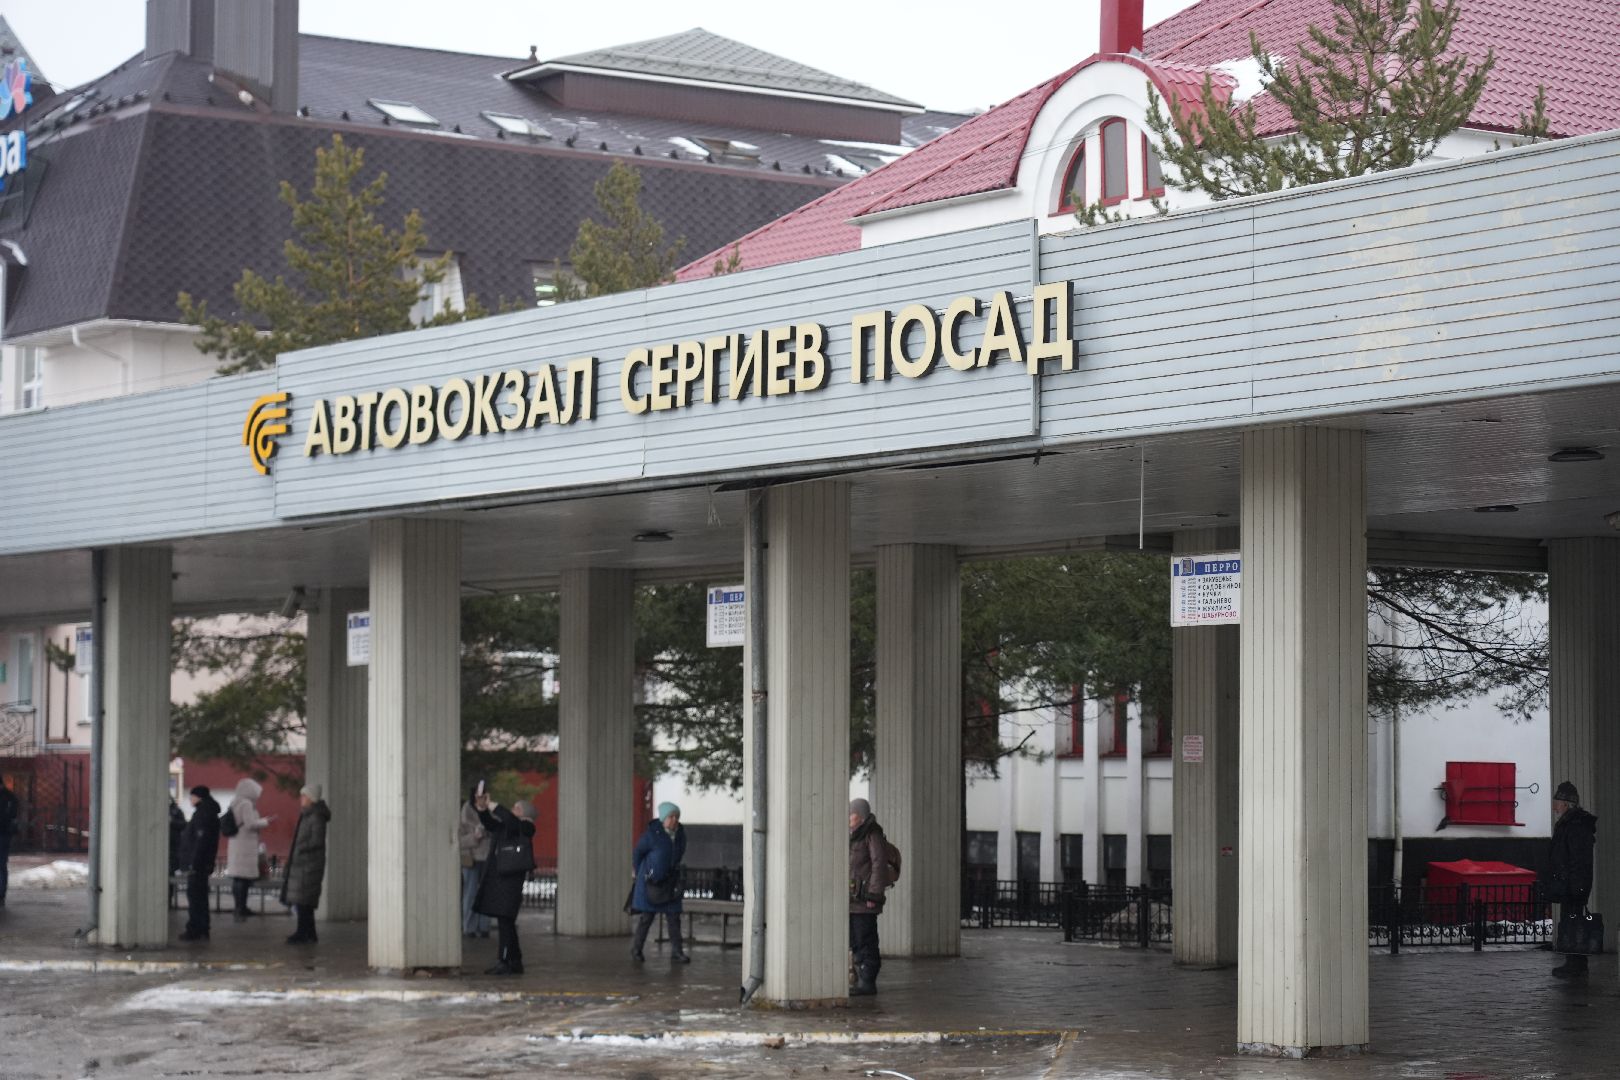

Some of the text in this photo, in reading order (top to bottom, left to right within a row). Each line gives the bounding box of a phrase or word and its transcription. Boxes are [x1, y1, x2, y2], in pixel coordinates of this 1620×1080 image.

[304, 280, 1079, 458] АВТОВОКЗАЛ СЕРГИЕВ ПОСАД
[1204, 562, 1239, 573] ПЕРРО
